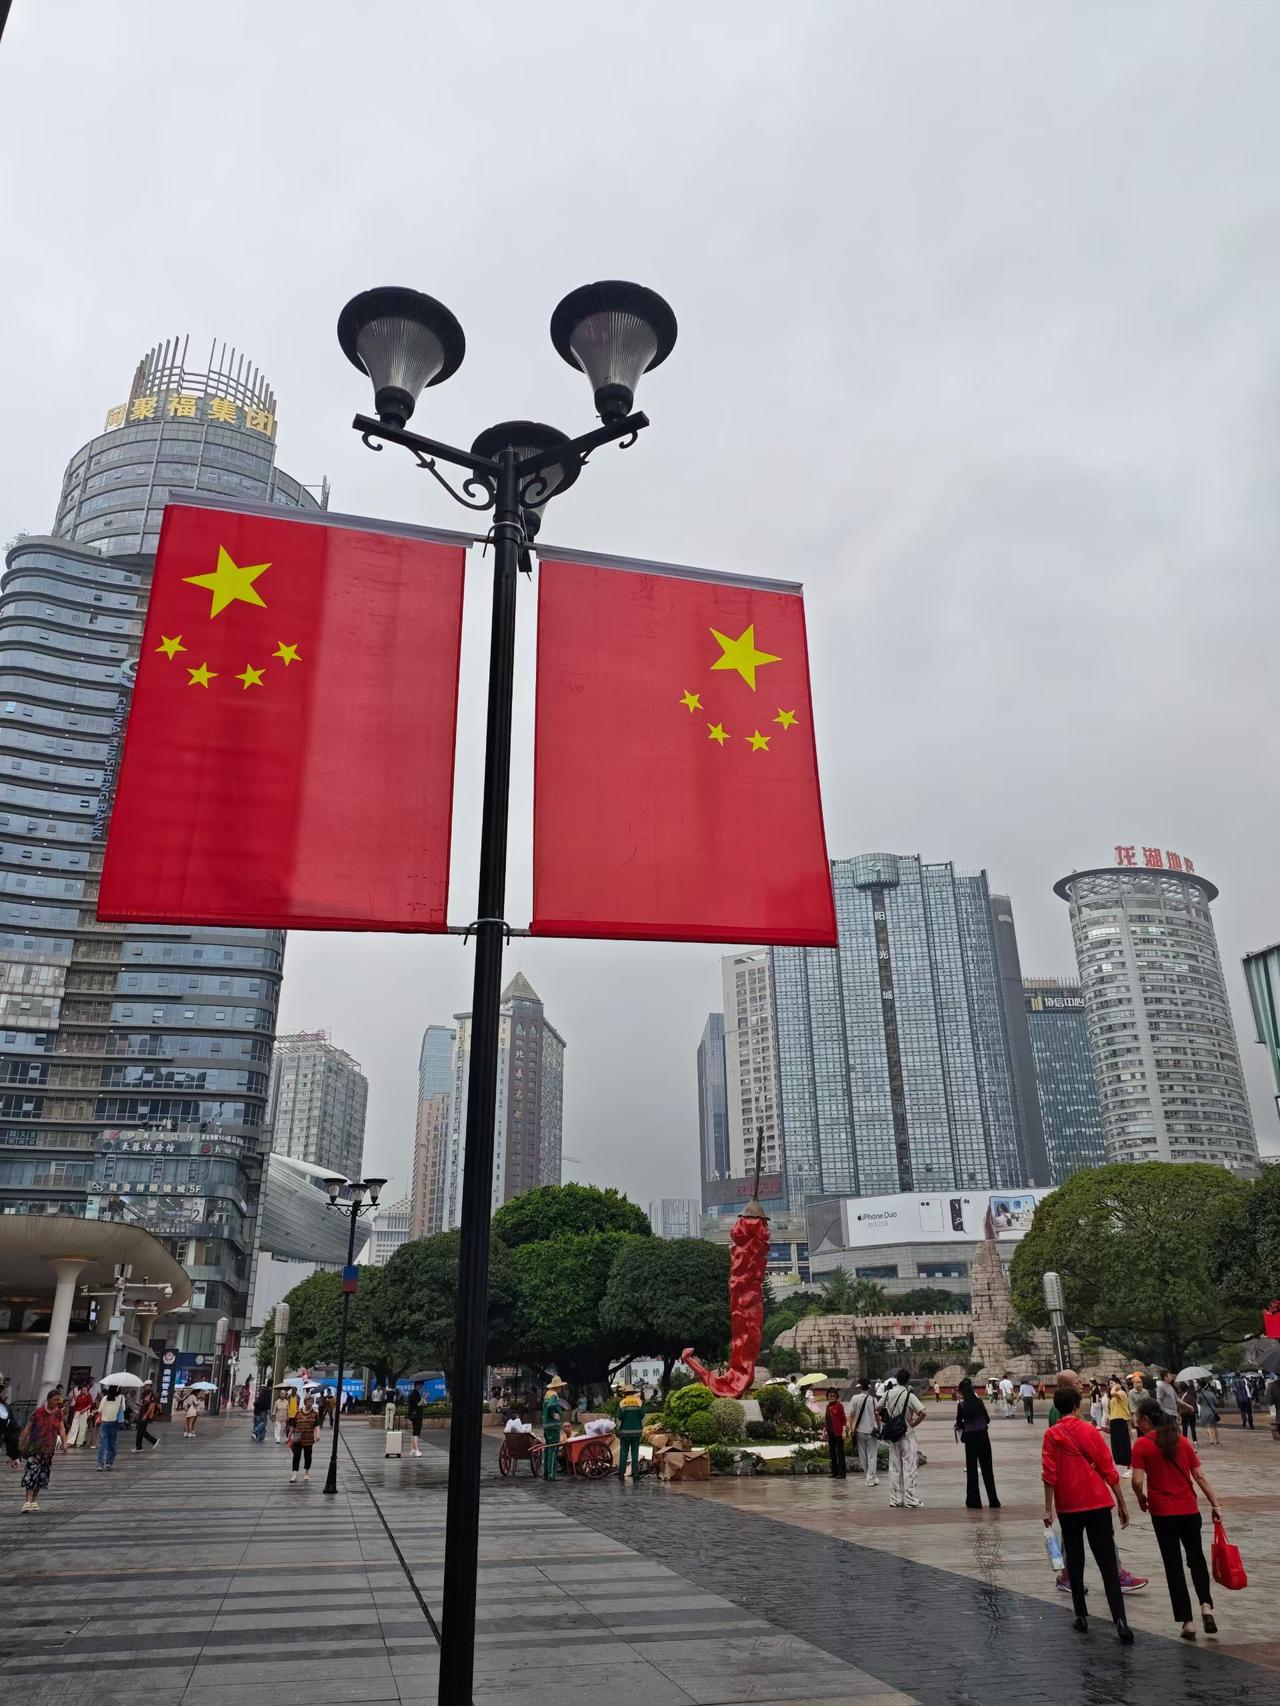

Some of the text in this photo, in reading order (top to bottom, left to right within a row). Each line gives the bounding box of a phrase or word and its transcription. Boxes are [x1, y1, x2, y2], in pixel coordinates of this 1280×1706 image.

[91, 696, 126, 840] CHINA MINSHENG BANK
[875, 911, 893, 1000] 阳光城
[1045, 997, 1085, 1008] 协信中心
